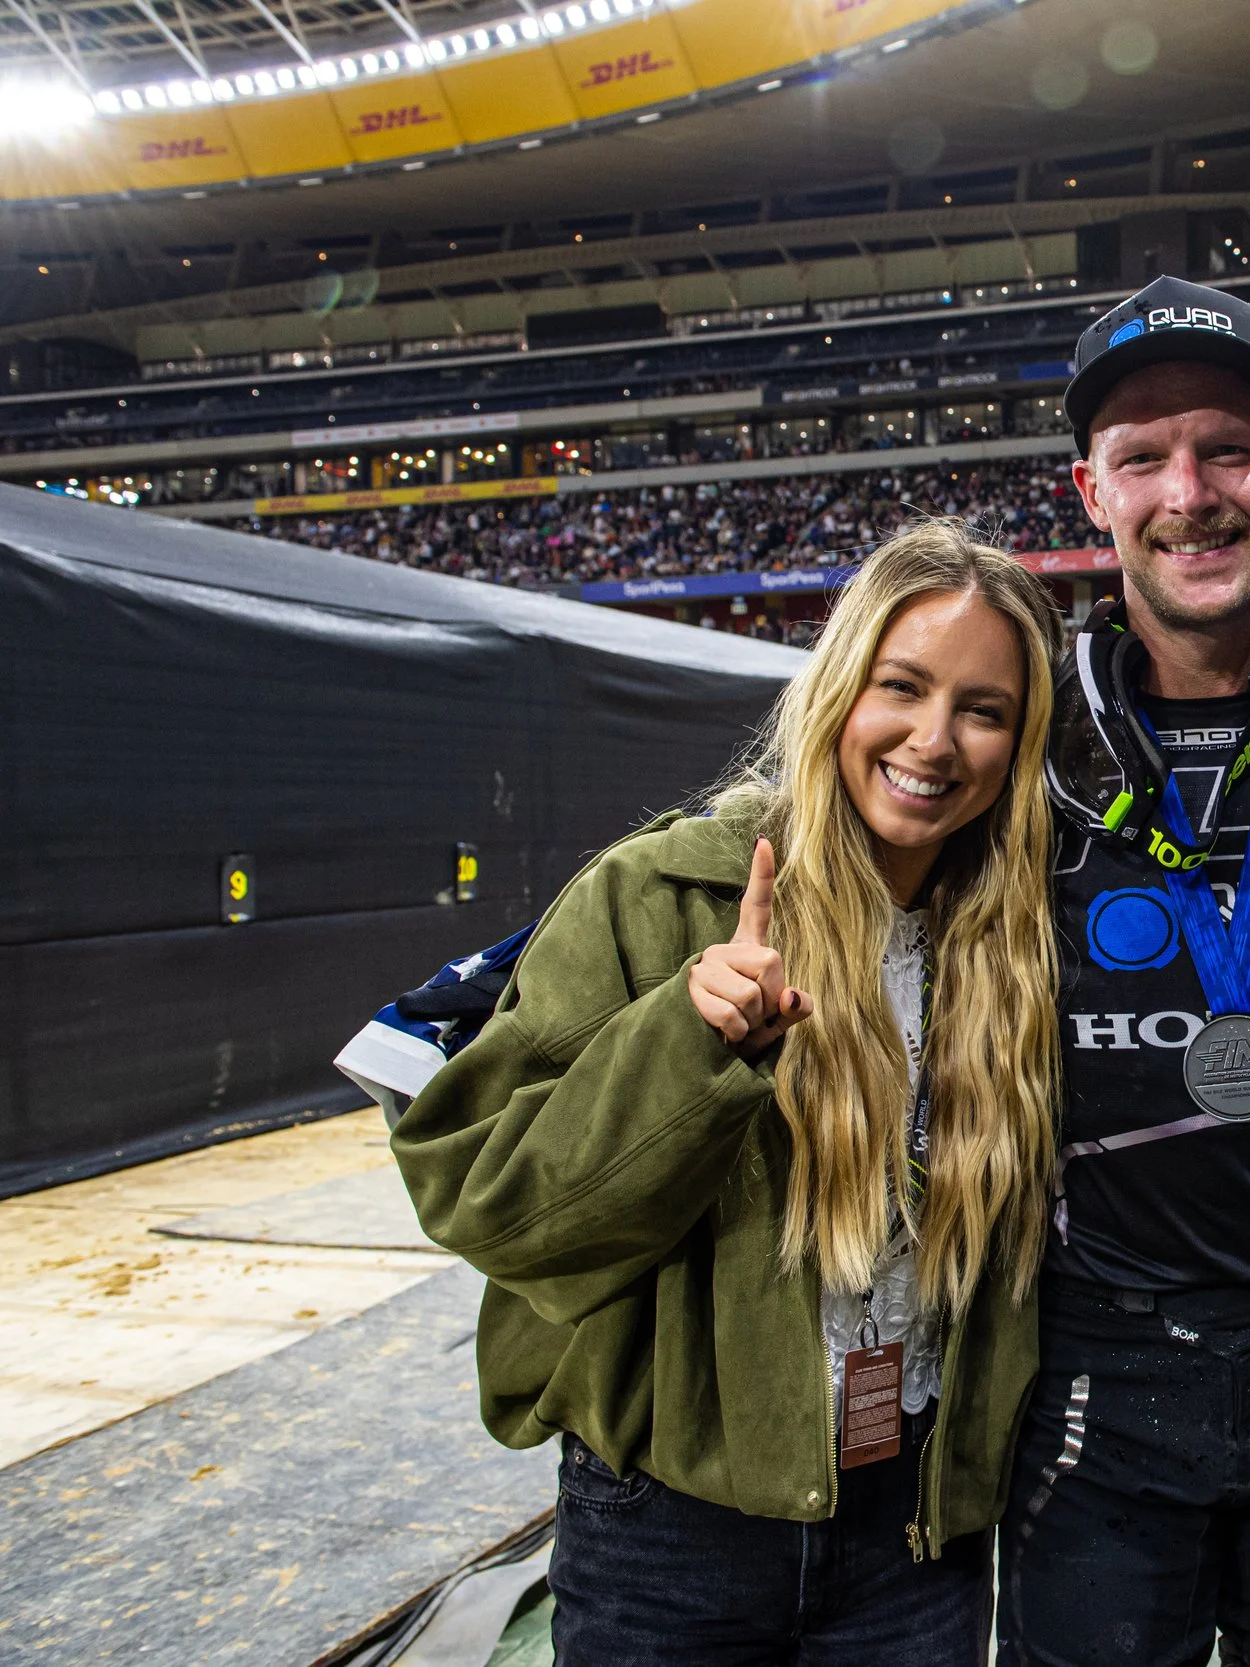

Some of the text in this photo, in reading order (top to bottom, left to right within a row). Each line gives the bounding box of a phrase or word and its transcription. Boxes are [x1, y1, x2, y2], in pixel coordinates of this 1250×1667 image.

[584, 51, 672, 87] DHL
[352, 105, 440, 135] DHL
[140, 137, 226, 161] DHL
[1149, 307, 1232, 330] QUAD
[229, 870, 248, 900] 9
